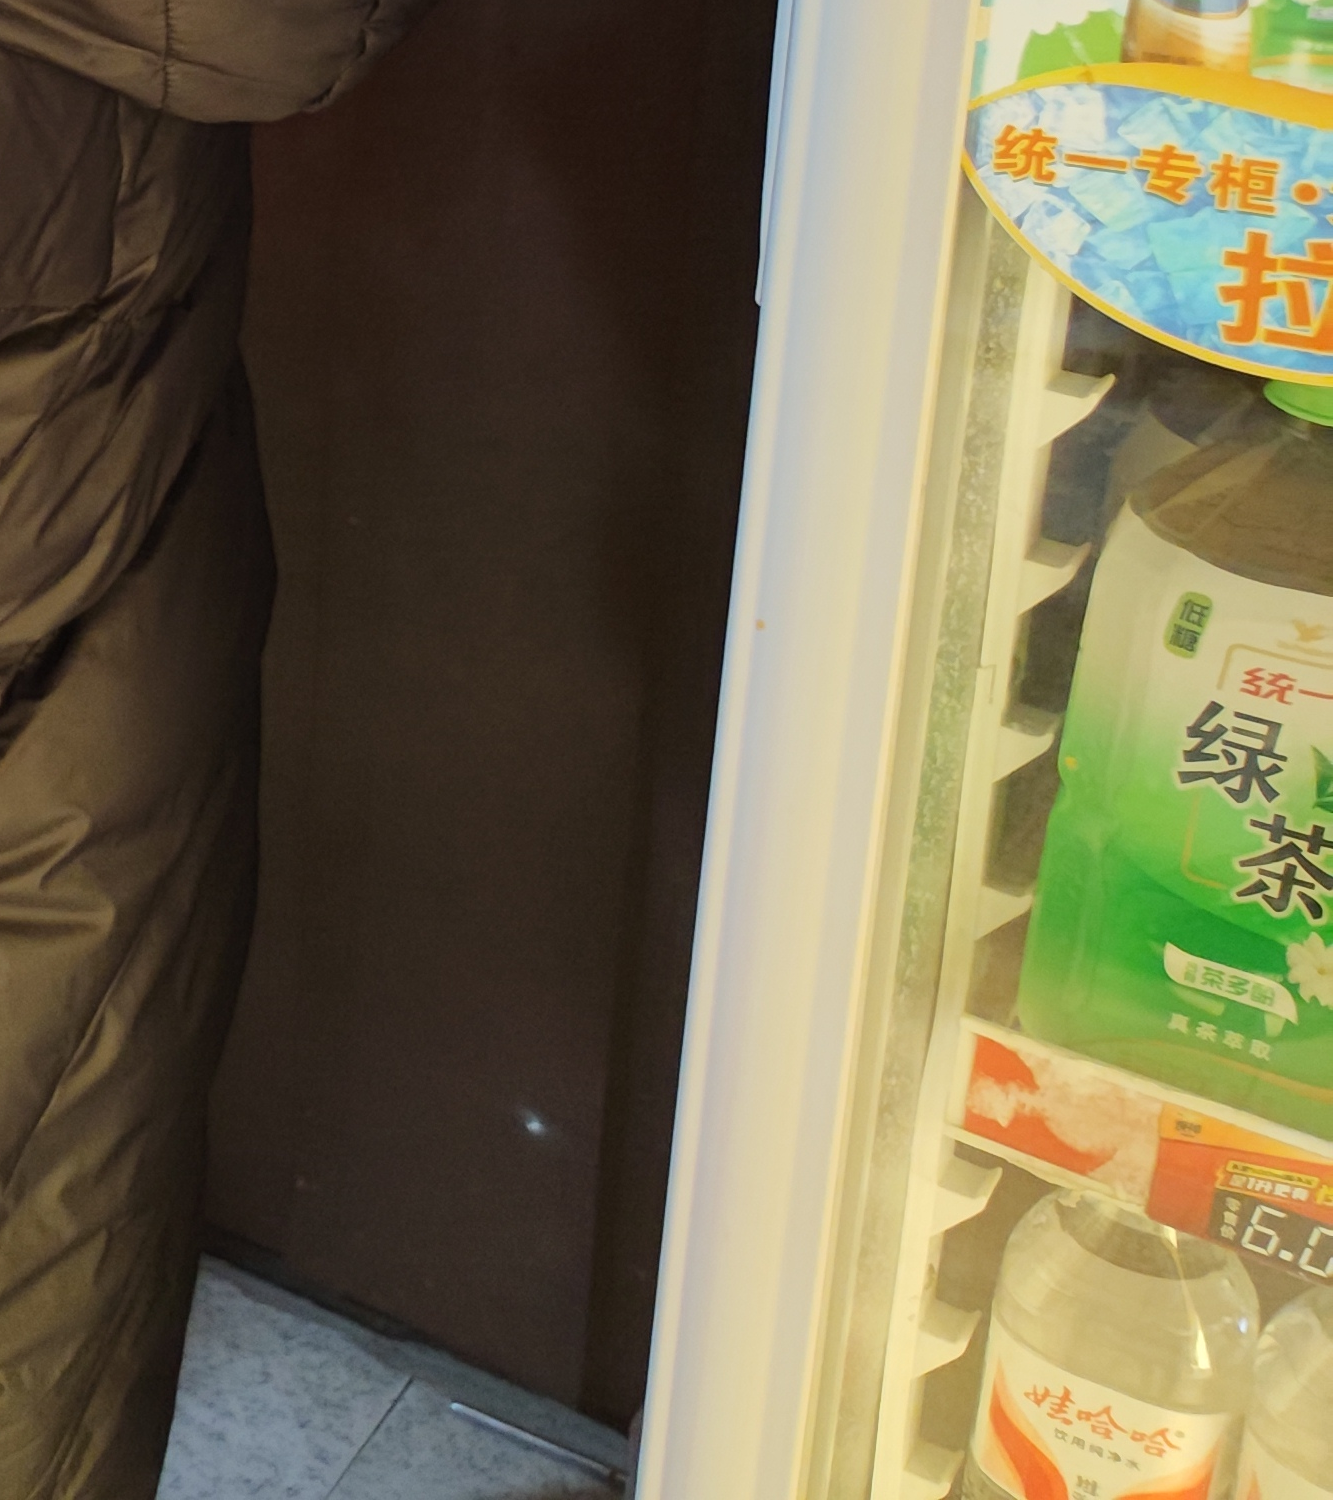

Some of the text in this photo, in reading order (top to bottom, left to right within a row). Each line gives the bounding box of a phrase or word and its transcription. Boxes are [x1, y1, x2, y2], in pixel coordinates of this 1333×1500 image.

[1219, 230, 1333, 352] 拉
[1023, 1384, 1182, 1459] 娃哈哈
